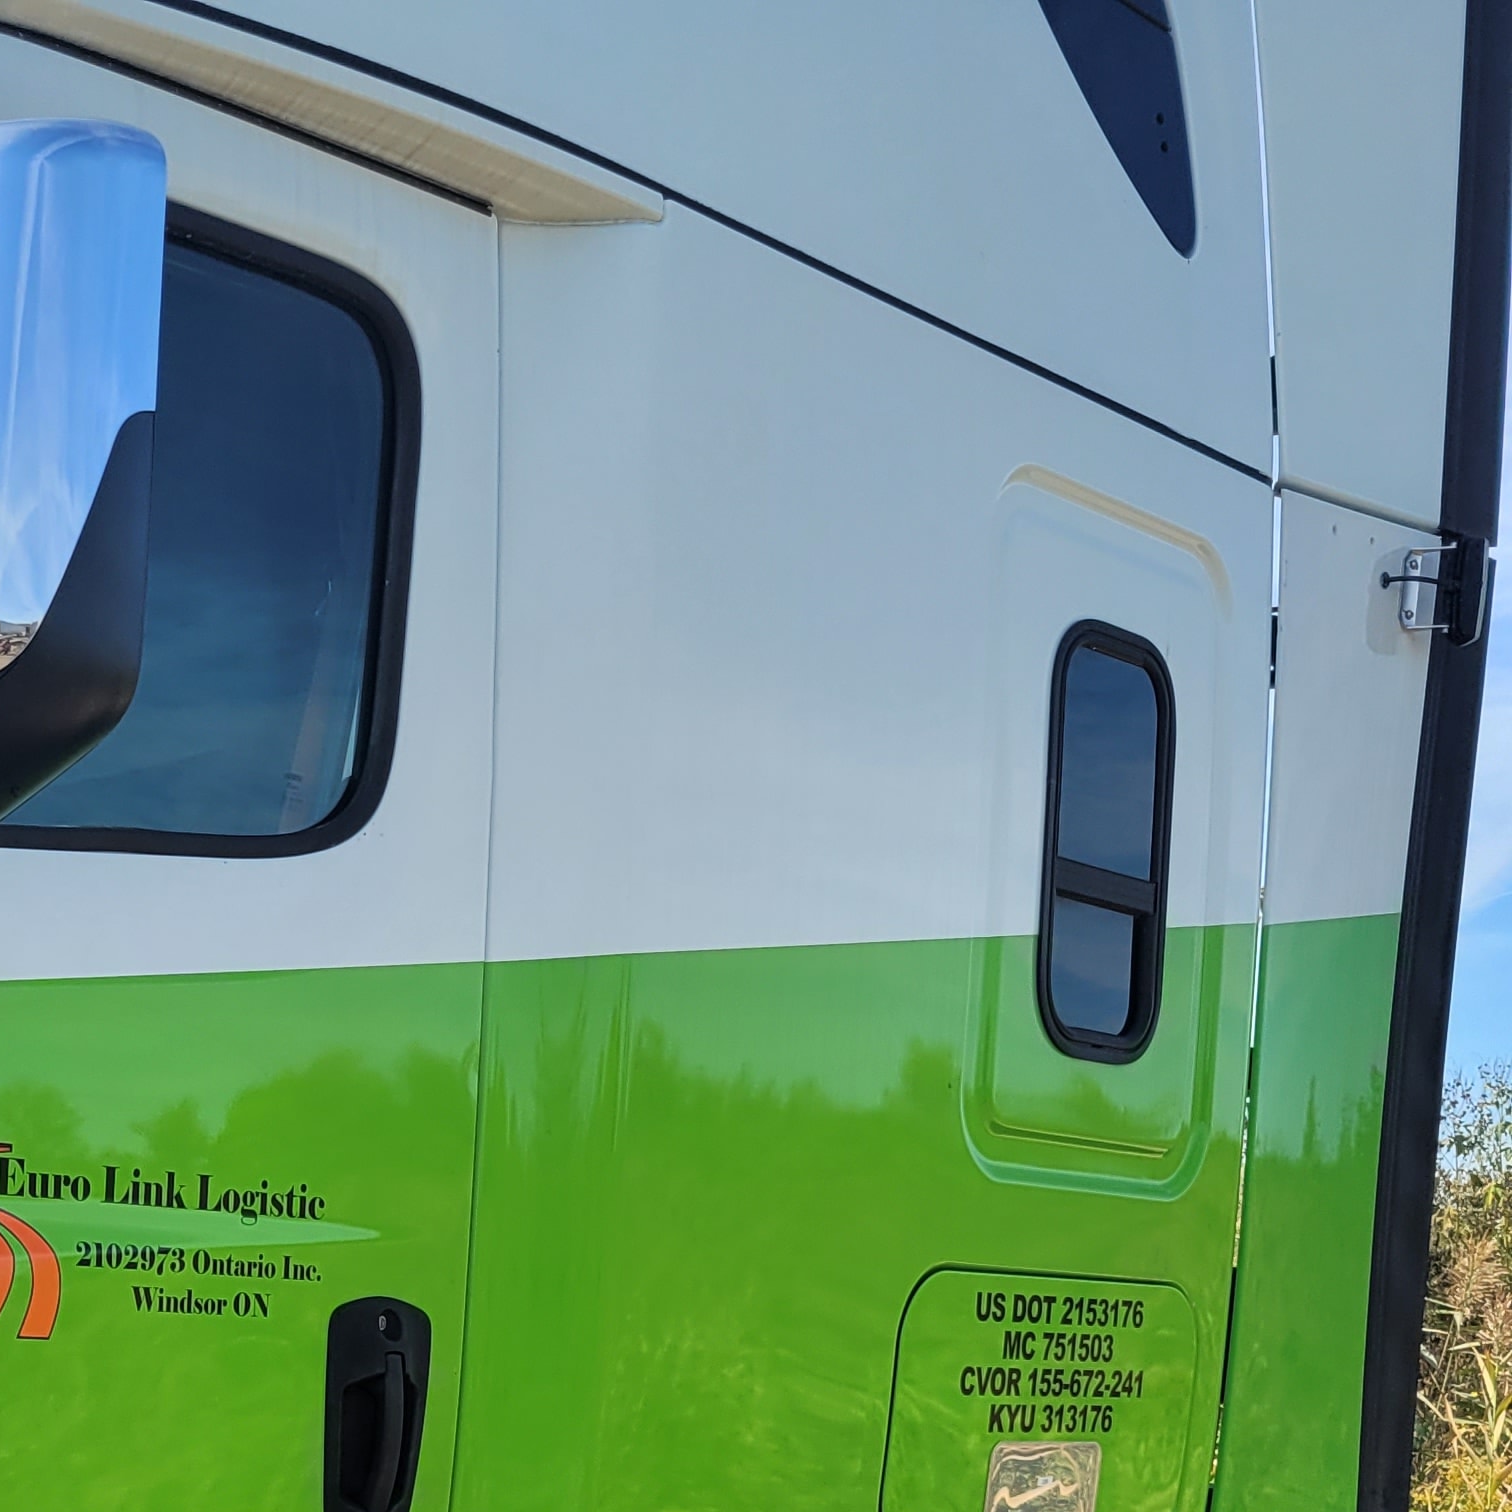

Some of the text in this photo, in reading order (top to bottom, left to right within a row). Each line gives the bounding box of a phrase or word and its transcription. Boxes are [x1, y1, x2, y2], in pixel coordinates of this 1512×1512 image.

[100, 1165, 188, 1209] Link
[194, 1173, 326, 1226] Logistic
[75, 1240, 322, 1282] 2102973 Ontario Inc.
[131, 1285, 272, 1319] Windsor ON
[976, 1291, 1145, 1328] US DOT 2153176
[1002, 1330, 1114, 1363] MC 751503
[959, 1366, 1144, 1399] CVOR 155-672-241
[988, 1403, 1113, 1433] KYU 313176
